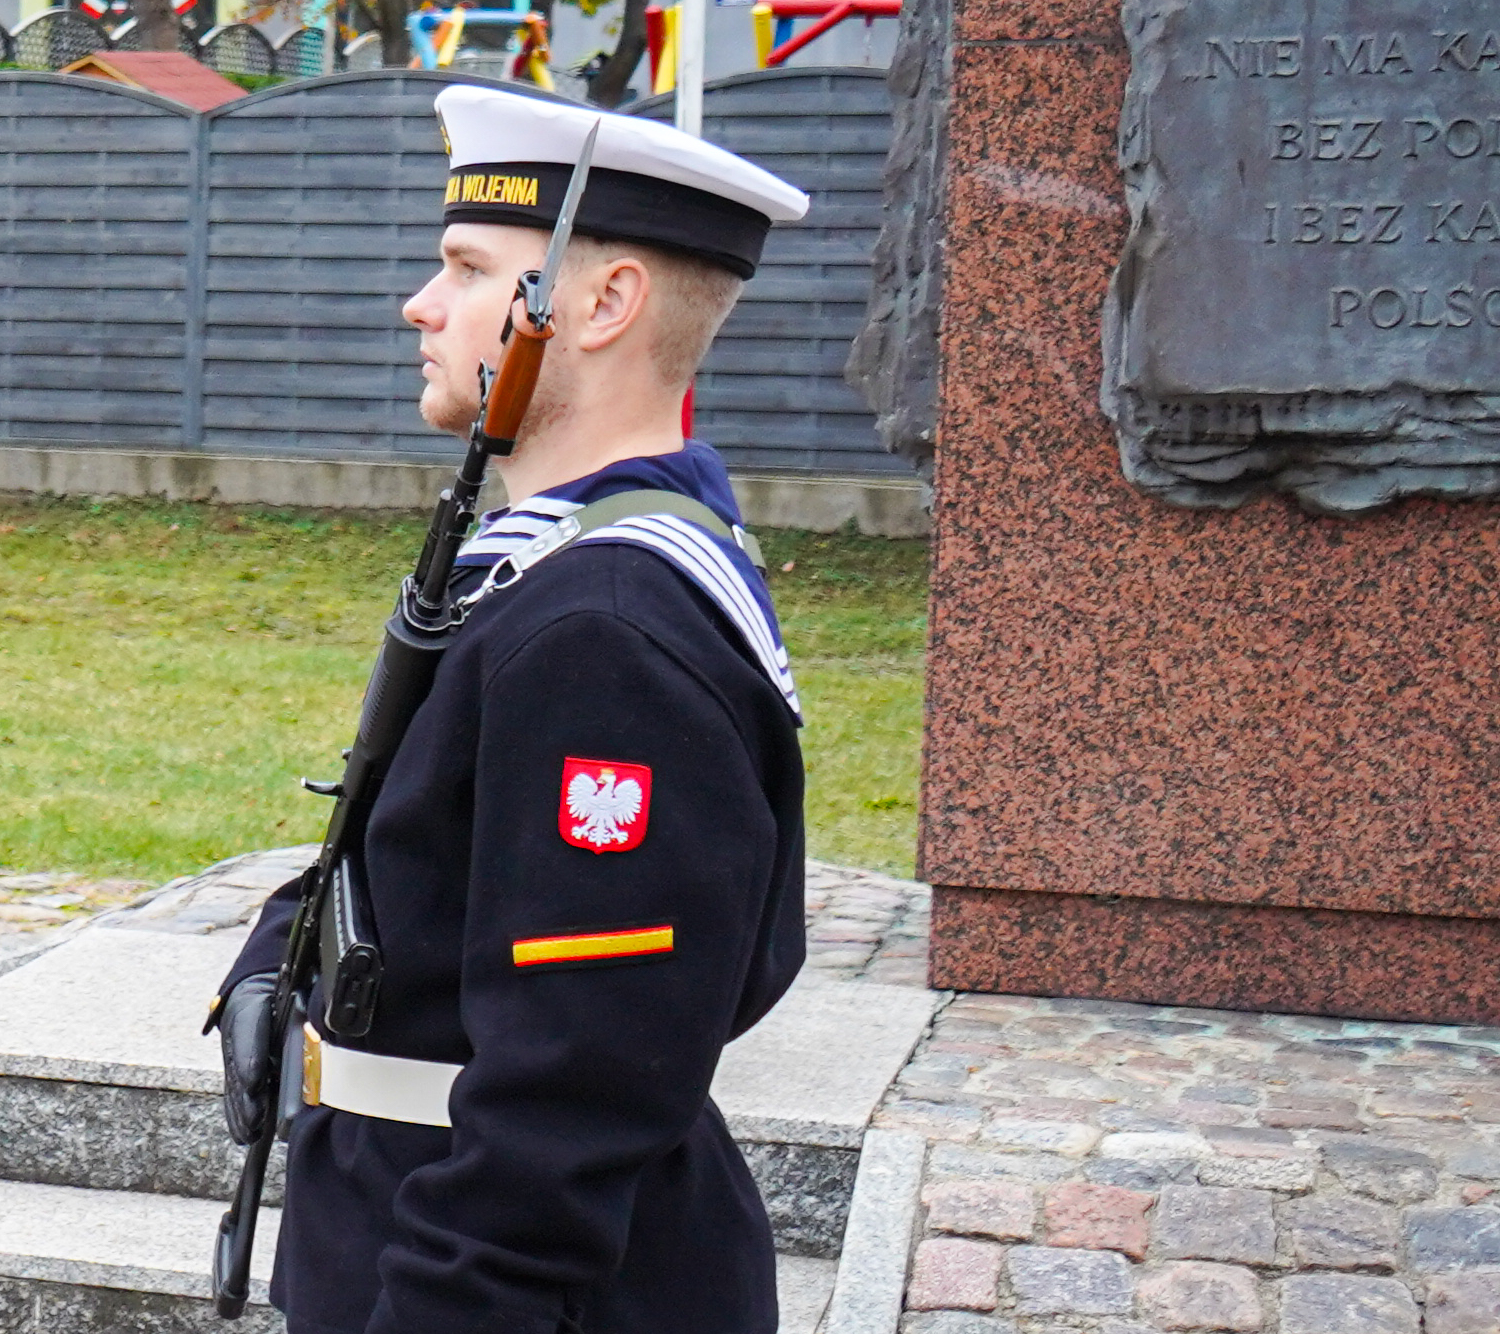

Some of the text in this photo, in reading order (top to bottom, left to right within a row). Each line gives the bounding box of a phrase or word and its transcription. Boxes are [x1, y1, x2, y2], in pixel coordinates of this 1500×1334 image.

[1322, 32, 1414, 76] MA
[1271, 118, 1384, 161] BEZ
[461, 174, 538, 207] WOJENNA
[1264, 202, 1278, 245] I
[1292, 202, 1405, 245] BEZ
